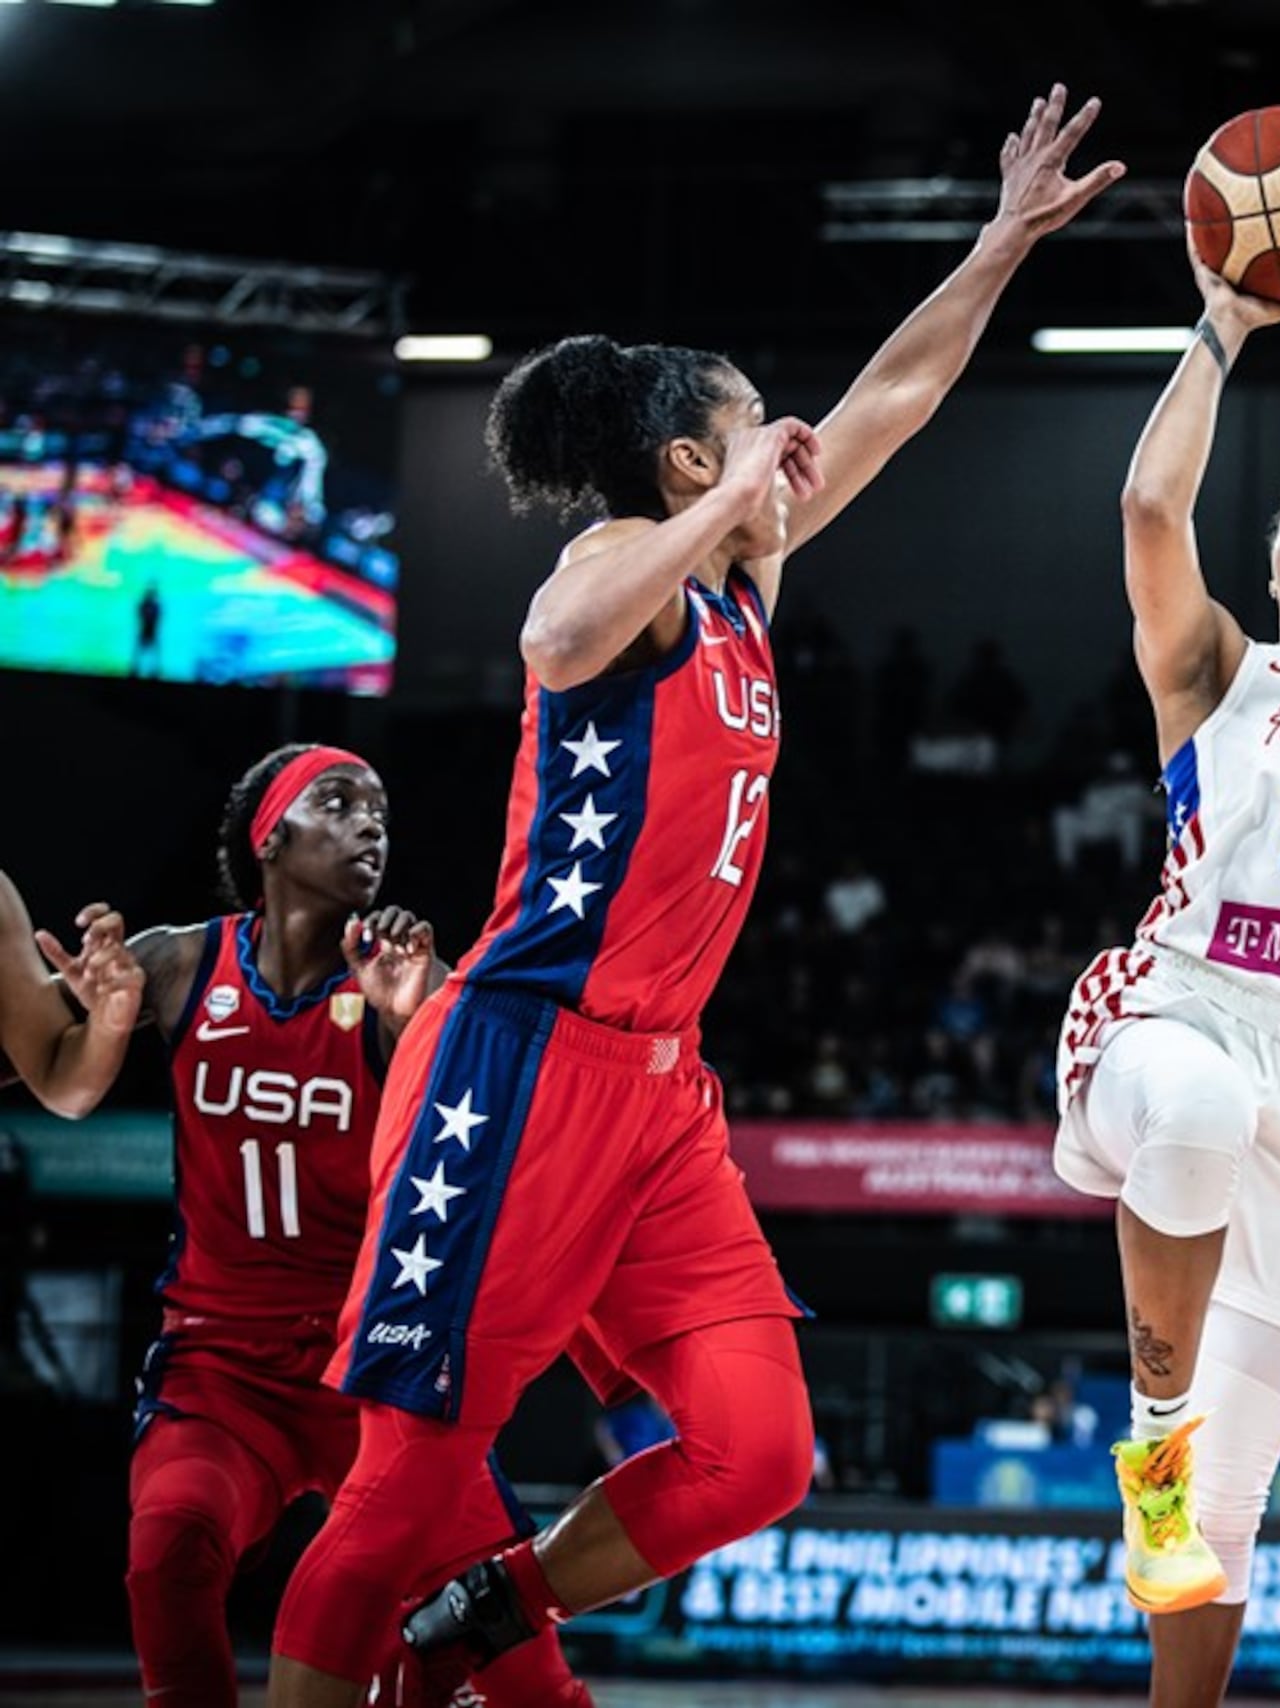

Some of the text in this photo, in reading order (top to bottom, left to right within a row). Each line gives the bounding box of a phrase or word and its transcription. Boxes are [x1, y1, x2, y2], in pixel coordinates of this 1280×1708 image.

[709, 768, 770, 887] 12
[193, 1060, 353, 1131] USA
[239, 1138, 301, 1239] 11
[367, 1321, 433, 1351] USA
[729, 1570, 845, 1624] BEST
[848, 1575, 1043, 1632] MOBILE
